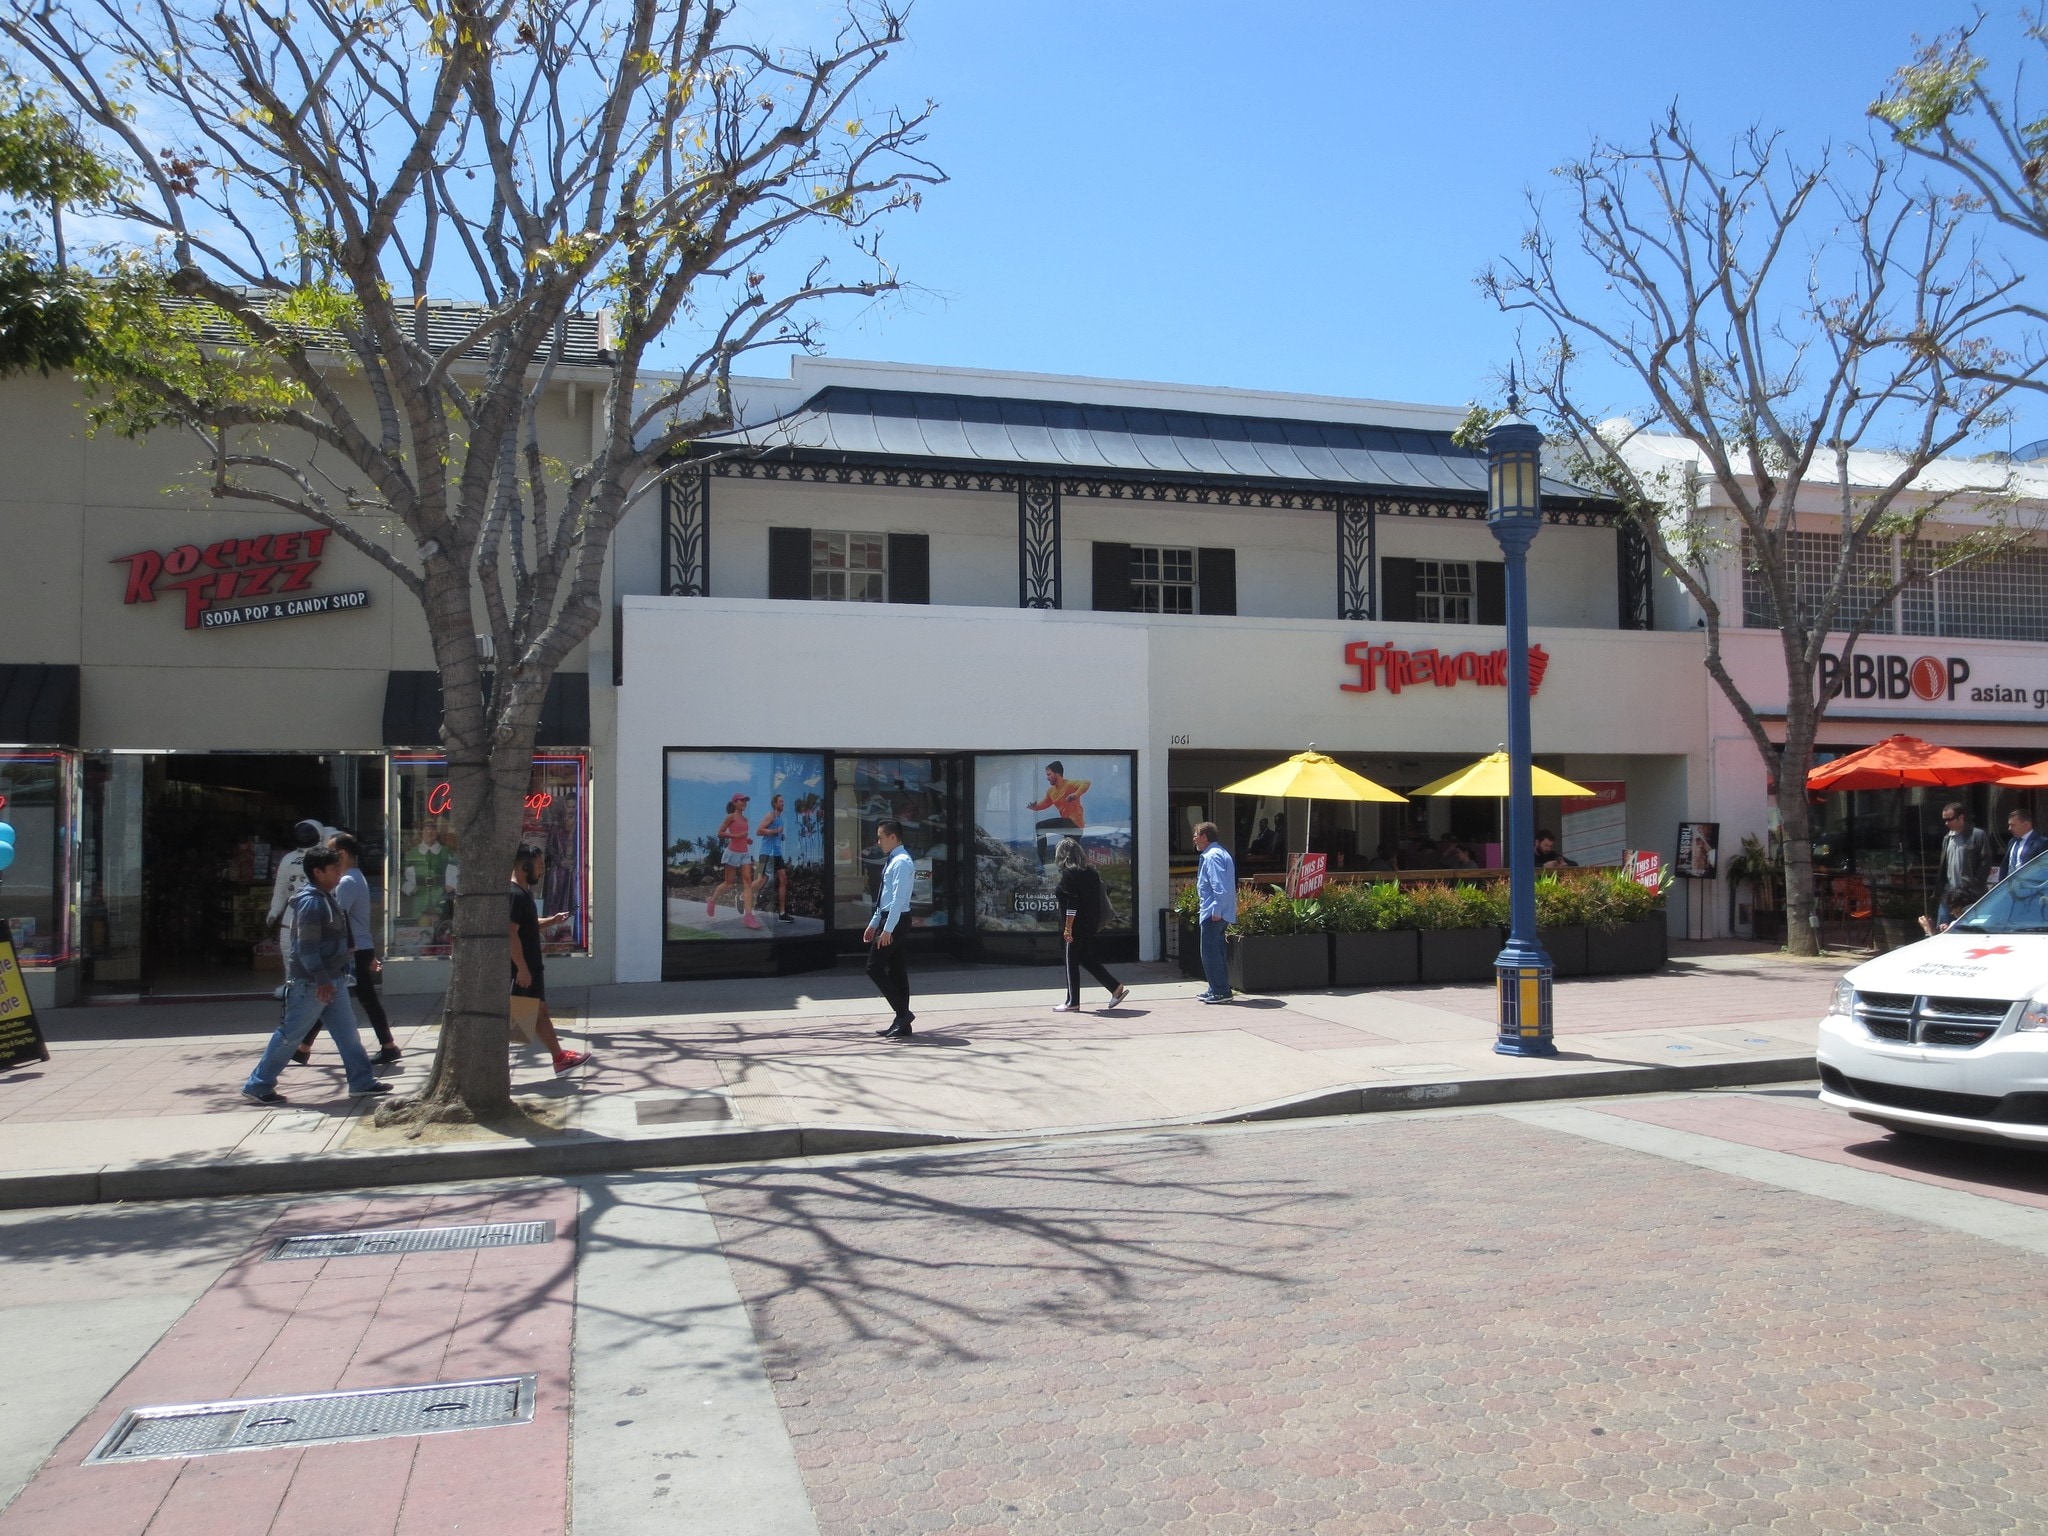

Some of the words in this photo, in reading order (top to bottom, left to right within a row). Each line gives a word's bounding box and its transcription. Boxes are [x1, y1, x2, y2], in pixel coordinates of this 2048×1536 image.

[109, 528, 333, 604] ROCKET
[154, 561, 322, 629] FIZZ
[205, 612, 241, 626] SODA
[245, 607, 270, 620] POP
[275, 605, 284, 616] &
[287, 597, 329, 615] CANDY
[333, 592, 366, 608] SHOP
[1971, 685, 2027, 703] asian
[1171, 734, 1190, 745] 1061
[1302, 861, 1316, 877] THIS
[1317, 856, 1325, 869] IS
[1636, 859, 1650, 873] THIS
[1651, 855, 1658, 867] IS
[1014, 899, 1059, 912] (310)551
[0, 996, 20, 1016] ore
